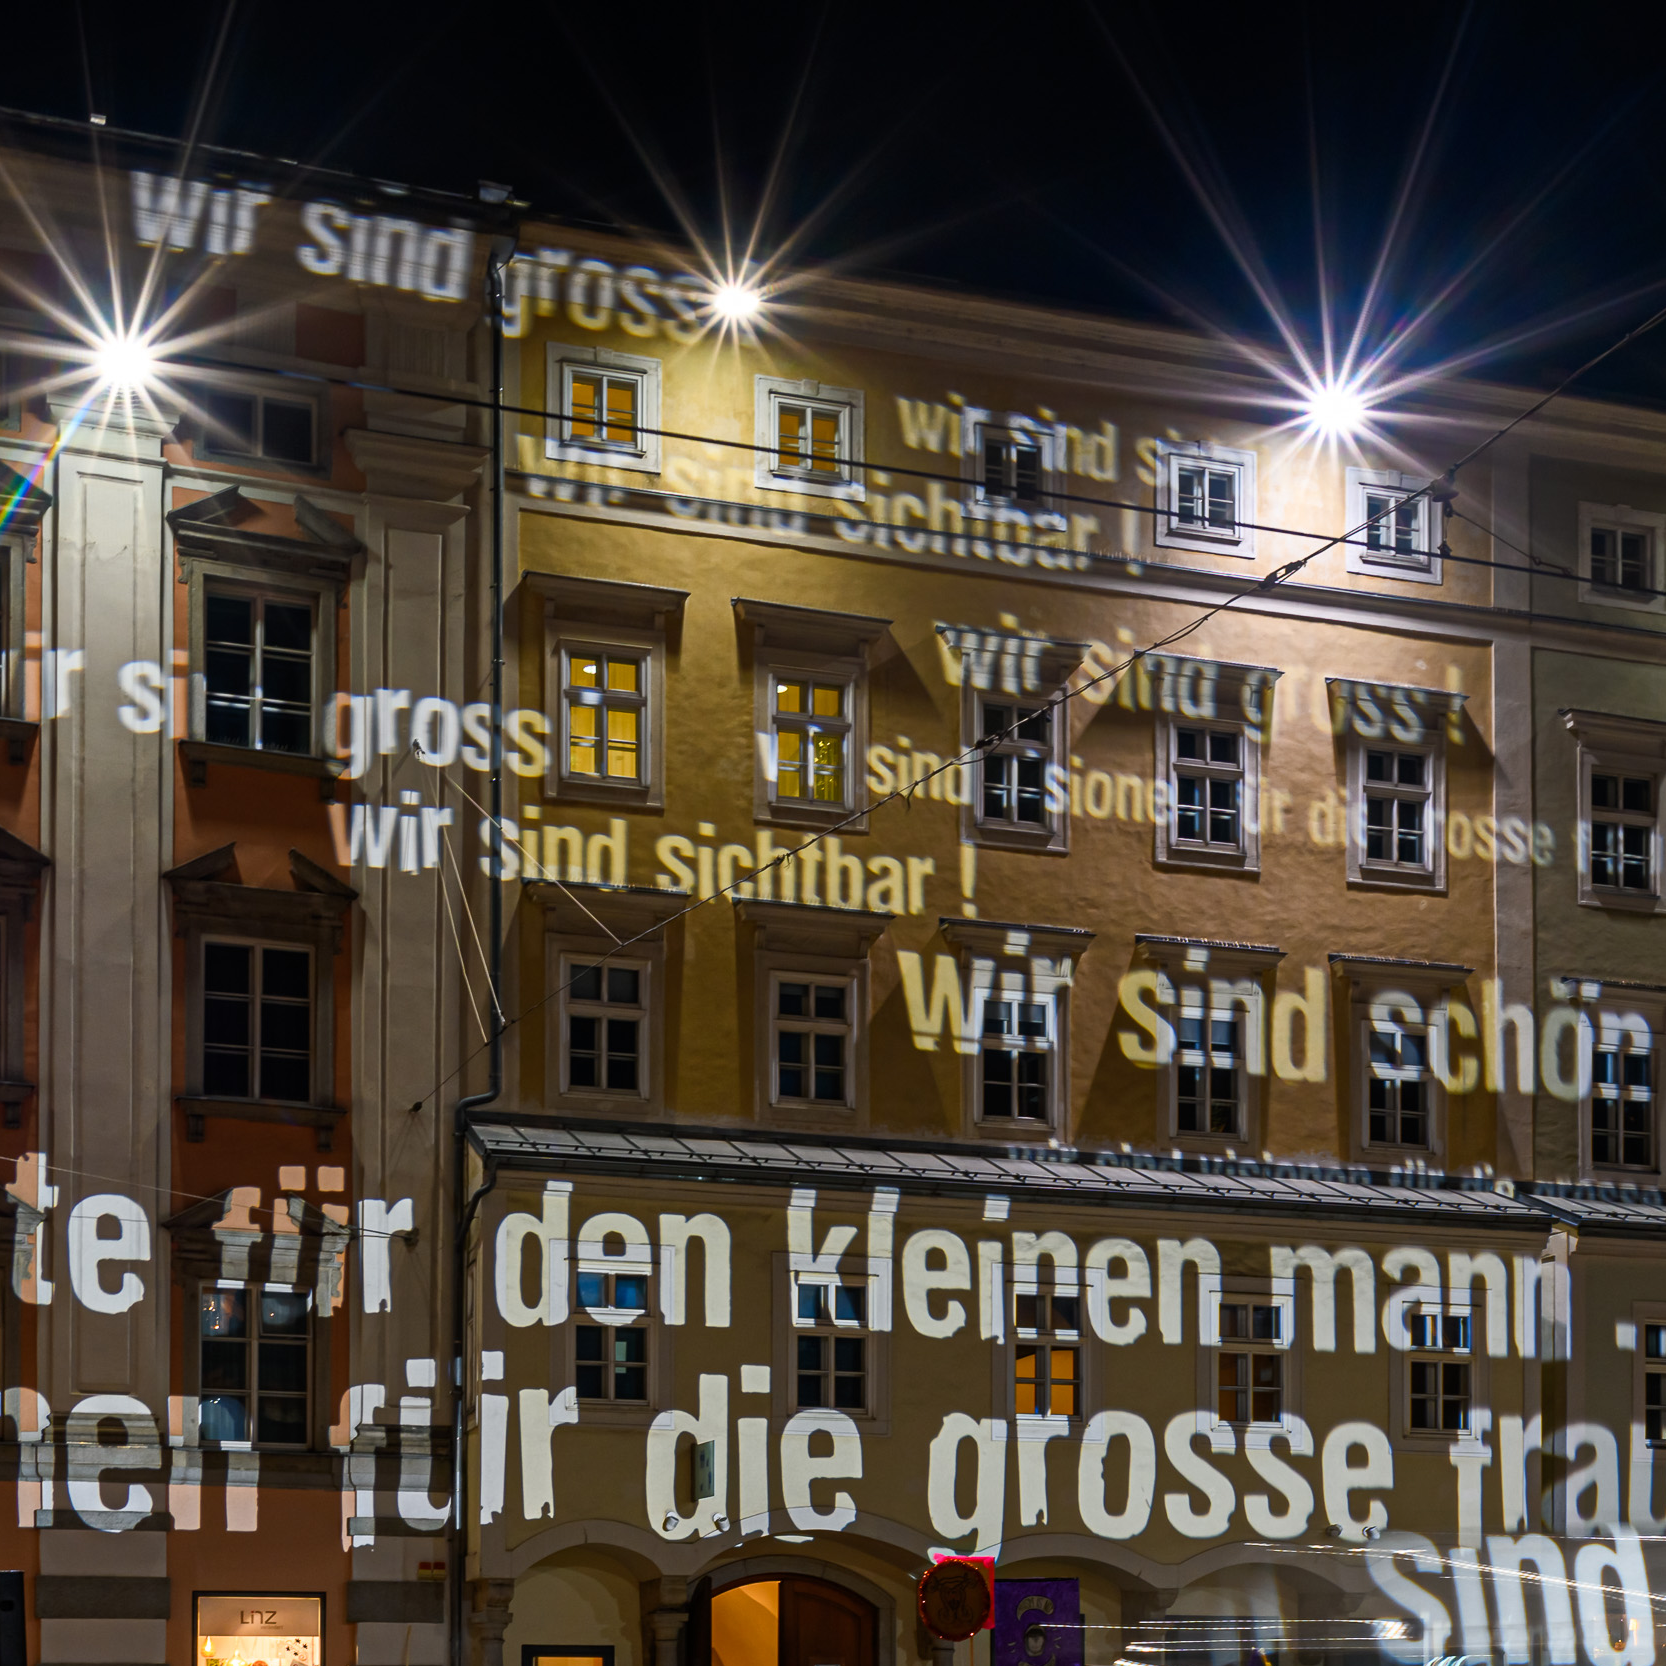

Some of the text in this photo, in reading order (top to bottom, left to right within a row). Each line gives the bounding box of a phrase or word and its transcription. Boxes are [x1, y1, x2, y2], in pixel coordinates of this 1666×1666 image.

[132, 168, 270, 257] wir
[297, 200, 474, 302] sind
[833, 472, 1099, 573] sichtbar
[323, 688, 553, 780] gross
[866, 733, 974, 807] sind
[328, 789, 453, 876] wir
[480, 806, 628, 885] sind
[655, 822, 937, 917] sichtbar
[1118, 946, 1328, 1085] sind
[1369, 978, 1654, 1103] schön
[203, 1165, 414, 1318] für
[494, 1180, 732, 1328] den
[788, 1186, 1223, 1347] kleinen
[1269, 1245, 1573, 1360] mann
[331, 1351, 579, 1553] für
[645, 1364, 864, 1542] die
[927, 1409, 1393, 1566] grosse
